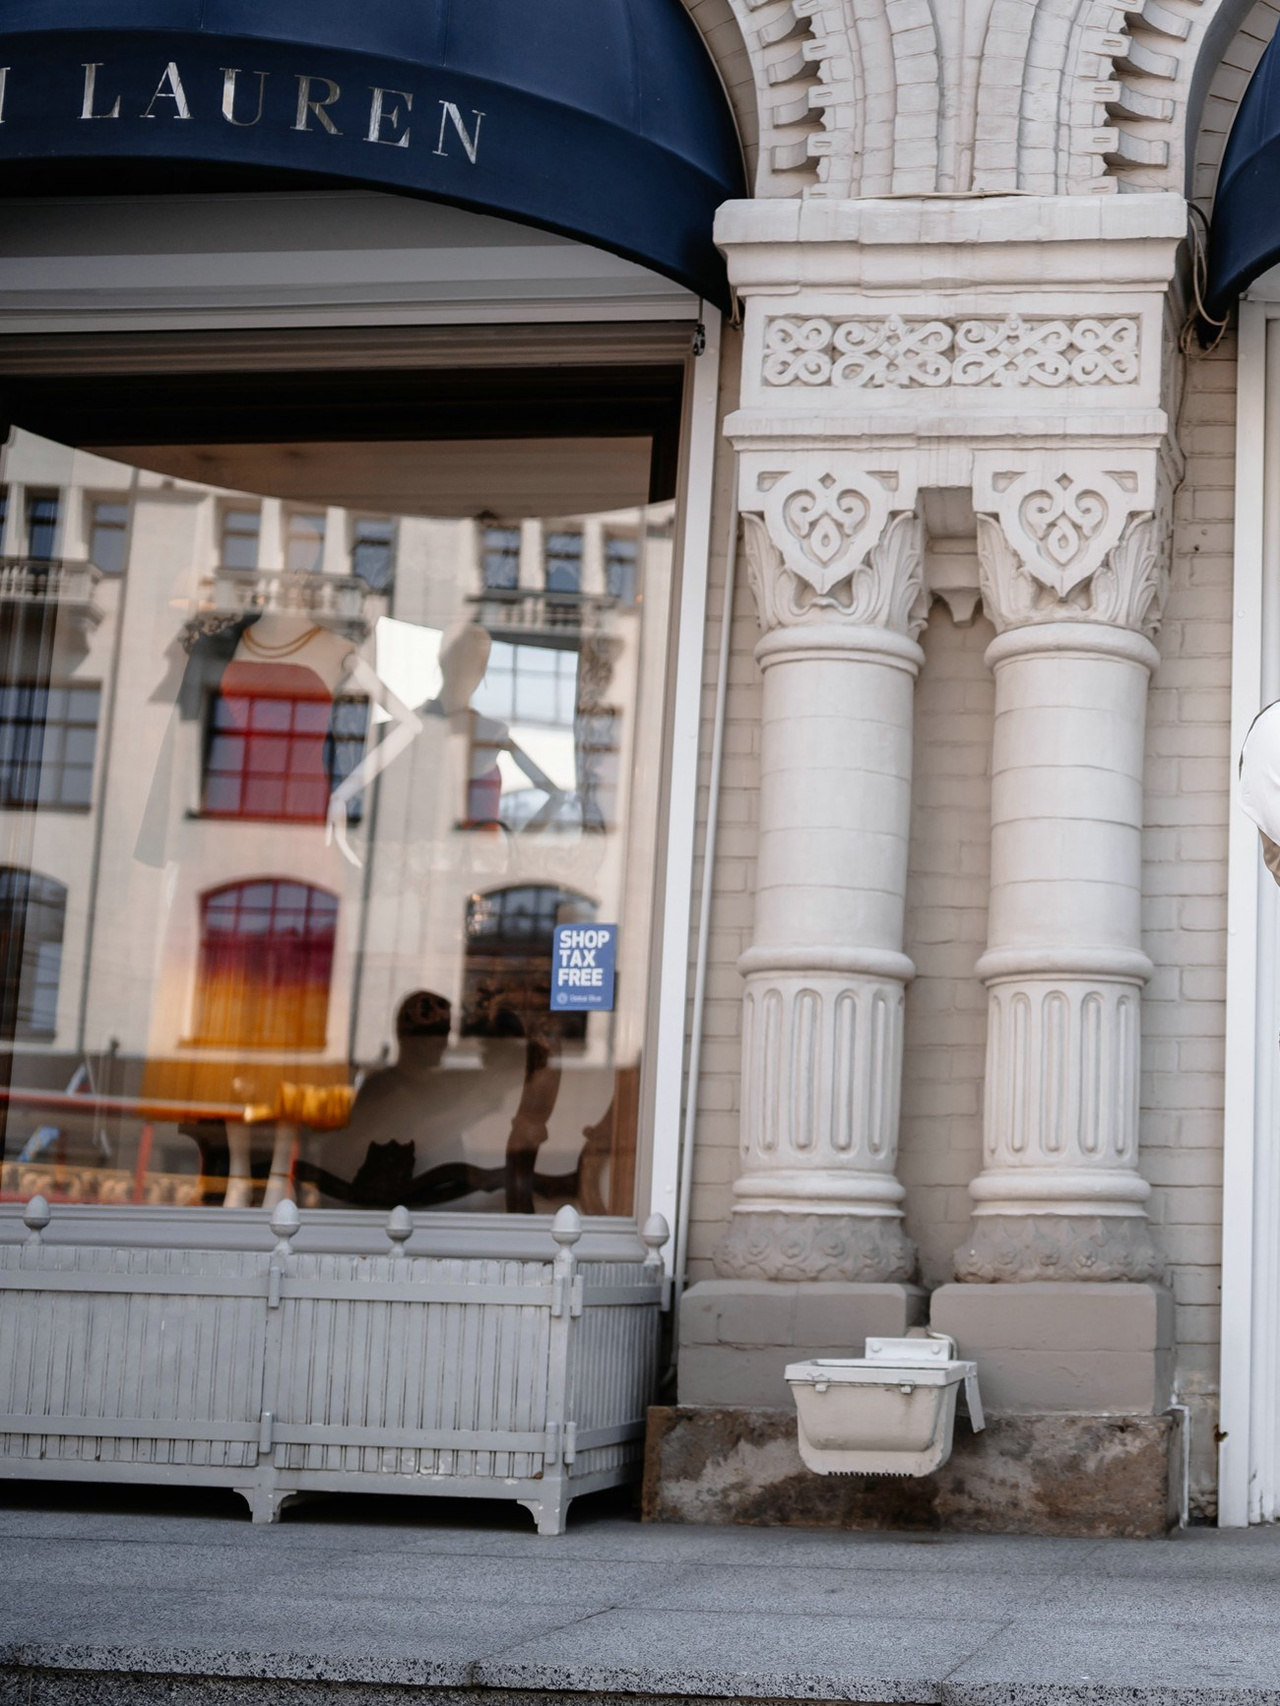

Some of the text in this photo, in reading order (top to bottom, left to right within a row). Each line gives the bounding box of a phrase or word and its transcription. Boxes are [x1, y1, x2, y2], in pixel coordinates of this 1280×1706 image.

[76, 61, 487, 165] LAUREN
[560, 930, 610, 949] SHOP
[559, 949, 596, 968] TAX
[558, 968, 604, 987] FREE
